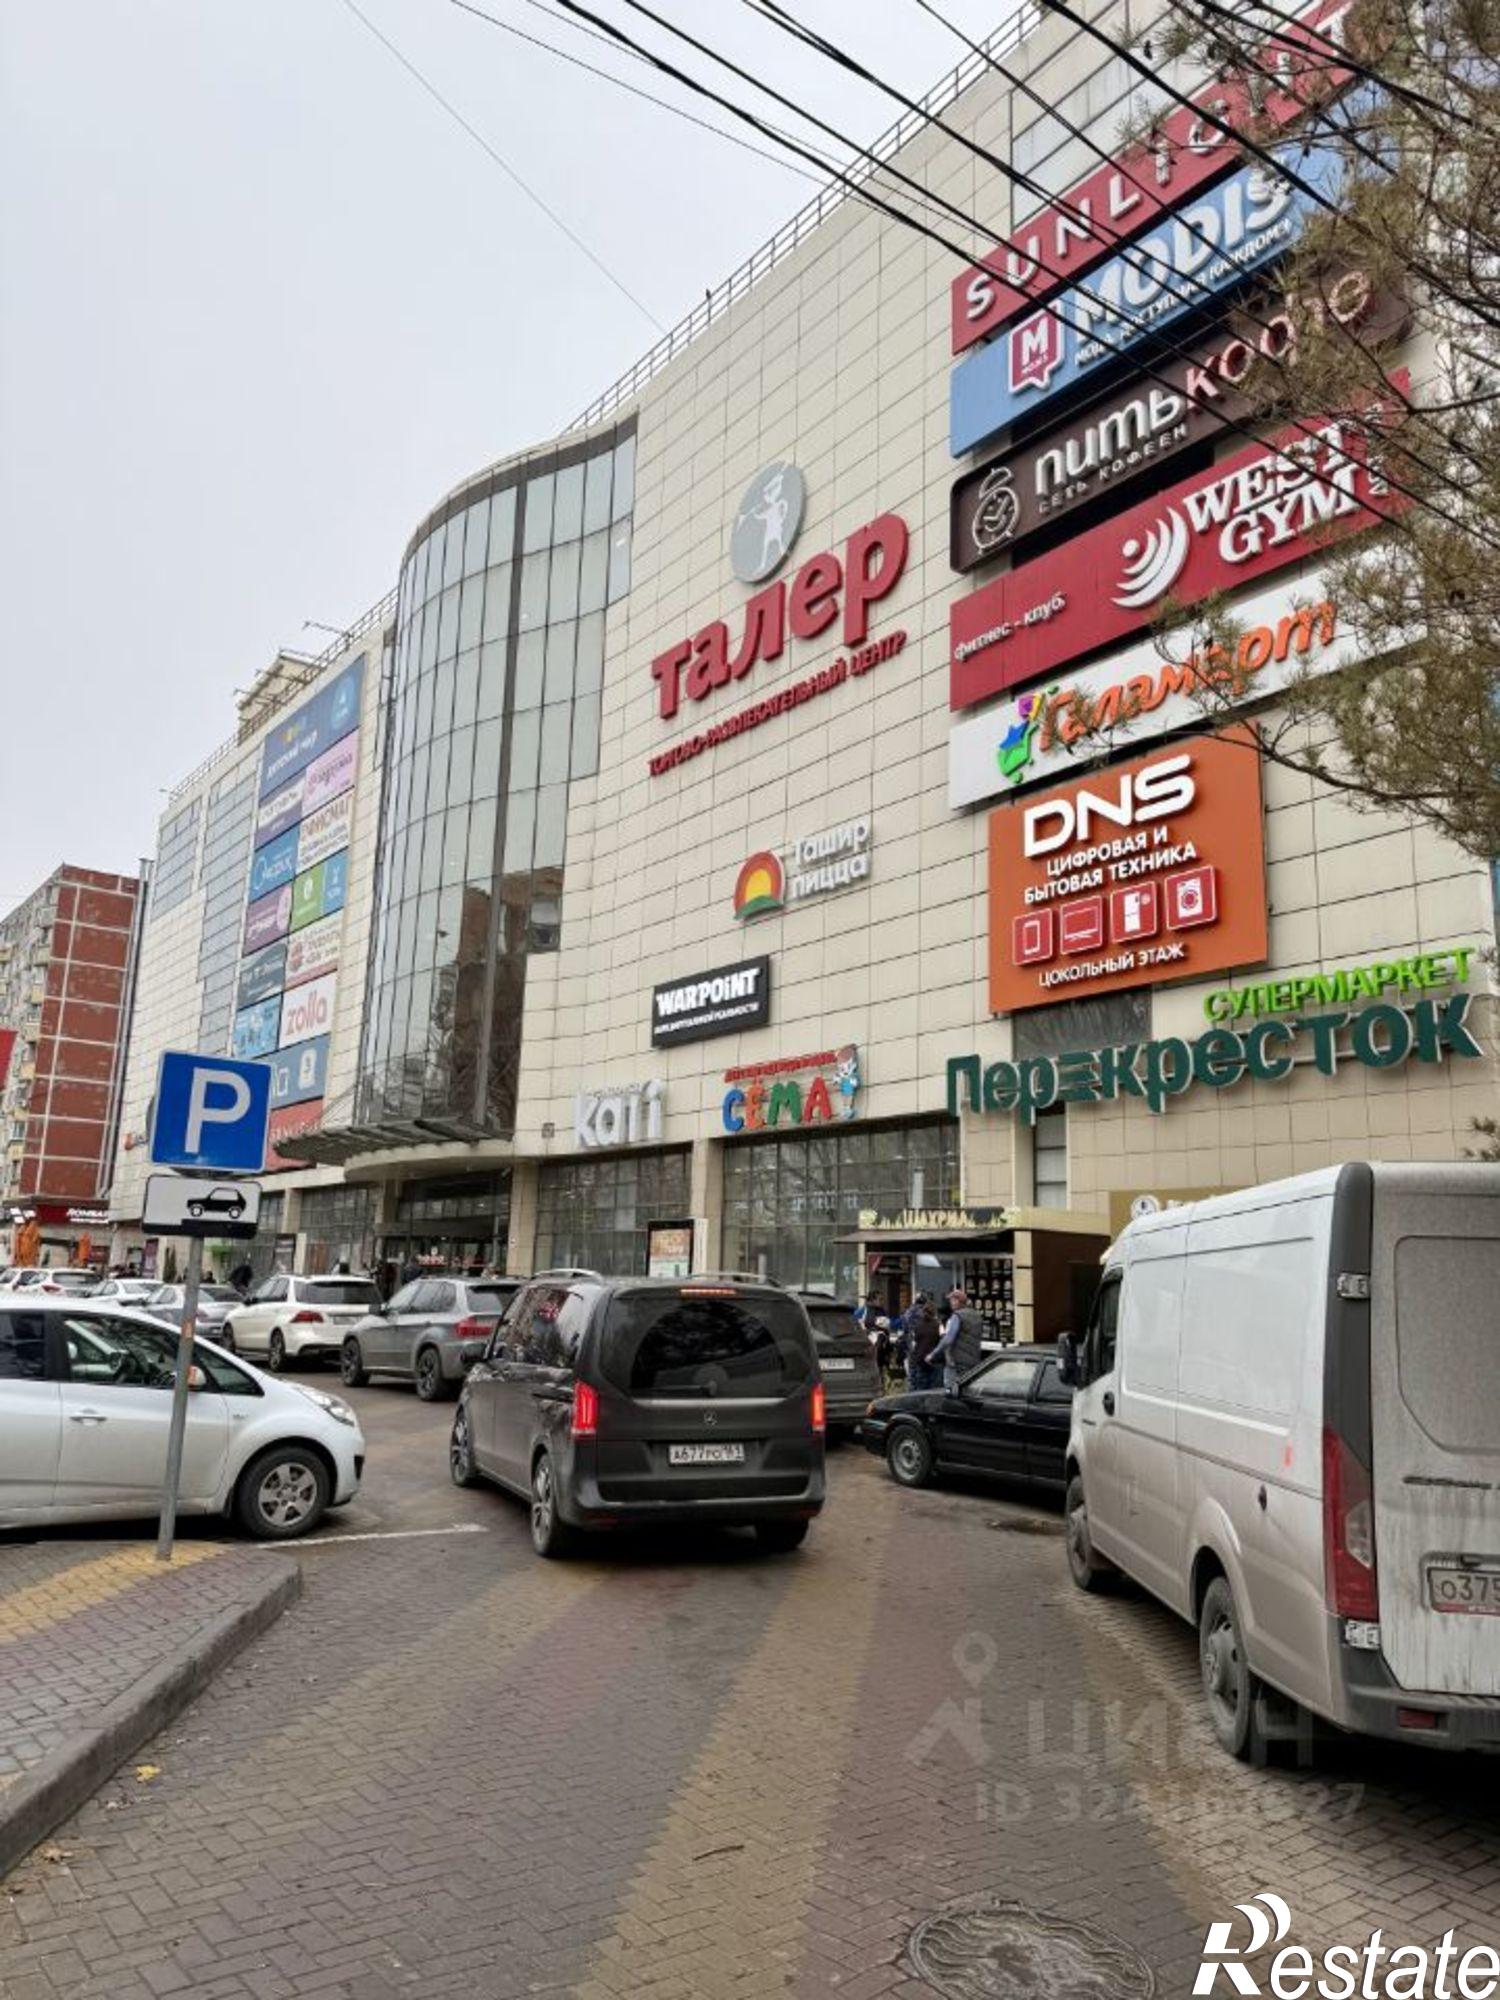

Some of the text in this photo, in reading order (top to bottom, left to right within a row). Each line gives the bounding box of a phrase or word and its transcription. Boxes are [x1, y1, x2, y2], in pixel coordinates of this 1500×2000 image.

[1073, 158, 1293, 347] MODIS
[1184, 416, 1360, 533] WEST
[1218, 462, 1361, 564] GYM
[849, 629, 908, 678] ЦЕНТР
[1024, 754, 1196, 859] DNS
[795, 814, 869, 866] Ташир
[1046, 825, 1168, 877] ЦИФРОВАЯ И
[1024, 841, 1198, 904] БЫТОВАЯ ТЕХНИКА
[1038, 942, 1185, 987] ЦОКОЛЬНЫЙ ЭТАЖ
[1203, 947, 1476, 1023] СУПЕРМАРКЕТ
[286, 990, 327, 1036] zolla
